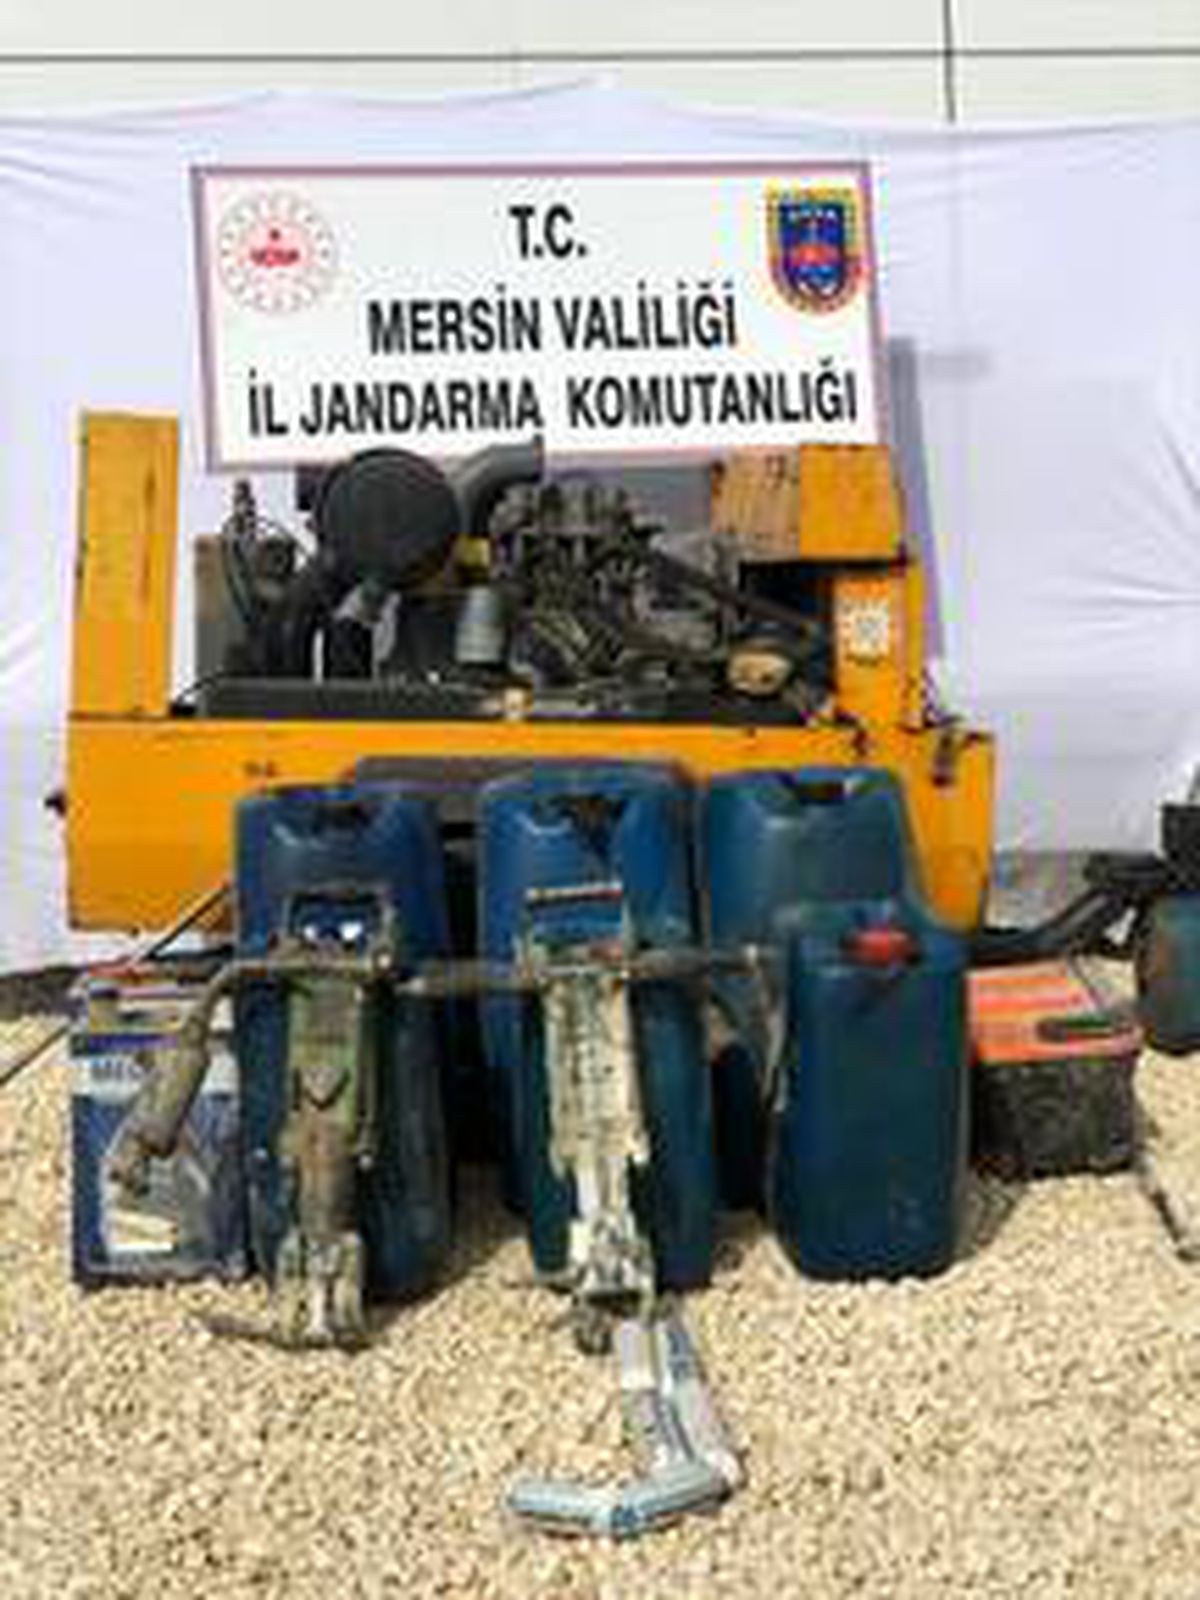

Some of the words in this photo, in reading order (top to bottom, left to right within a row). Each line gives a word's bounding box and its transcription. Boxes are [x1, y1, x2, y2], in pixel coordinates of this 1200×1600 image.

[509, 204, 587, 259] T.C.
[368, 283, 541, 355] MERSİN
[553, 280, 737, 351] VALİLİĞİ
[248, 369, 289, 436] İL
[300, 380, 543, 433] JANDARMA
[567, 358, 857, 429] KOMUTANLIĞI
